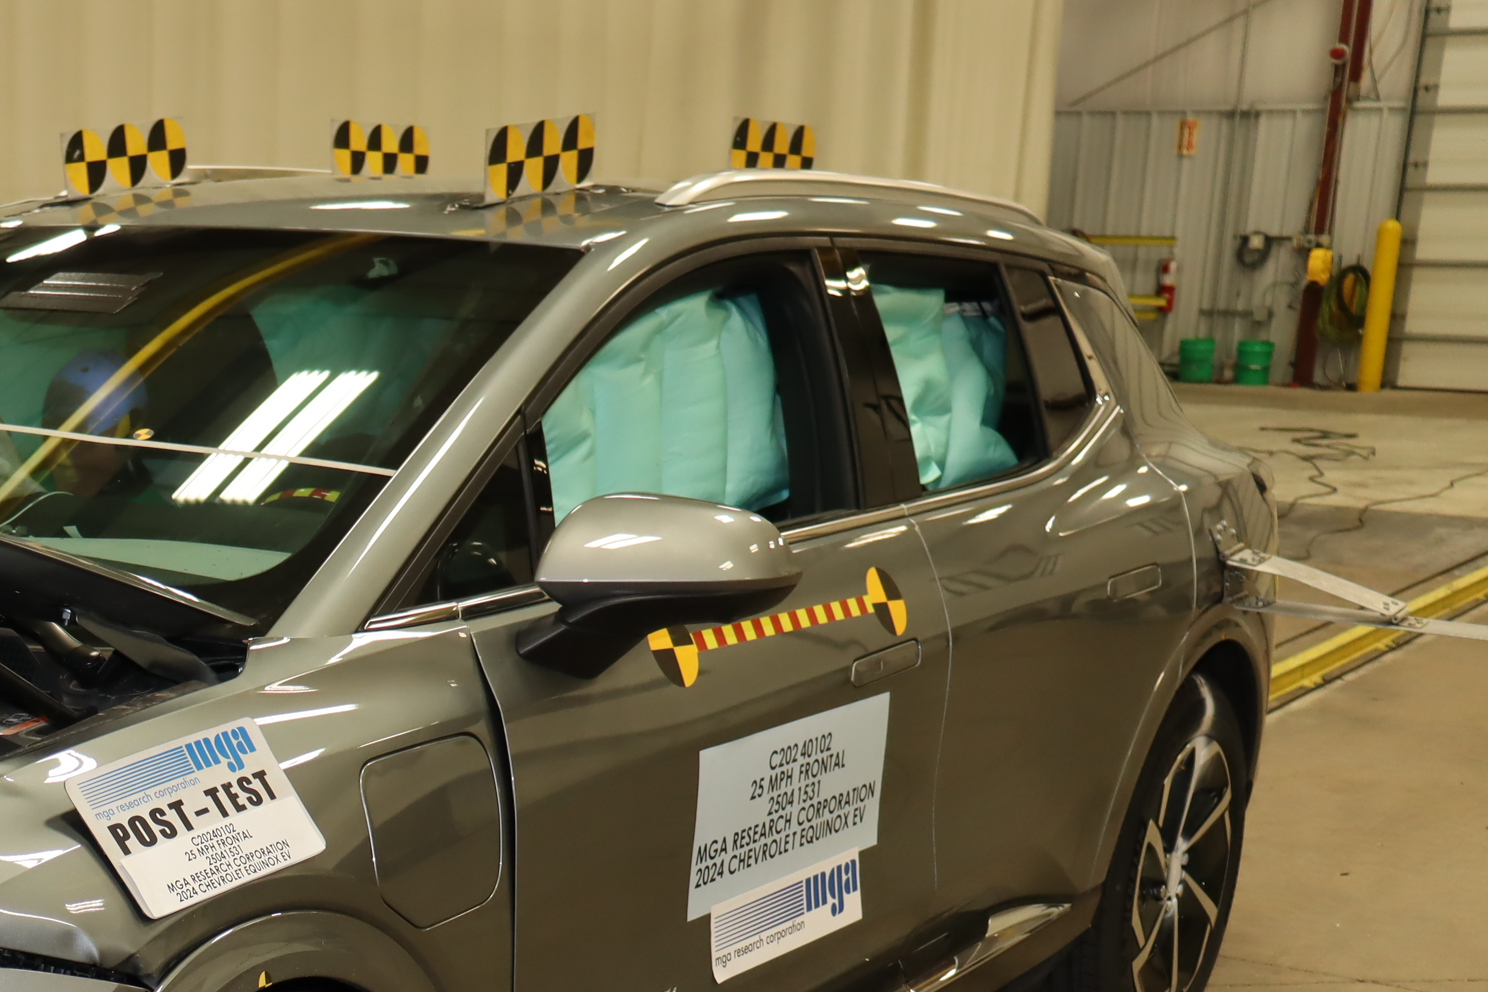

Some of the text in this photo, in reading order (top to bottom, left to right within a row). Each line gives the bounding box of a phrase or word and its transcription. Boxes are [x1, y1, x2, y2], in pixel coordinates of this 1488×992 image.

[185, 726, 257, 773] mga
[94, 775, 201, 821] mga research corporation
[749, 750, 845, 801] 25 MPH FRONTAL
[184, 829, 253, 861] 25 MPH FRONTAL
[191, 823, 237, 846] C20240102
[694, 805, 866, 889] 2024 CHEVROLET EQUINOX EV
[695, 780, 876, 866] MGA RESEARCH CORPORATION
[167, 839, 290, 894] MGA RESEARCH CORPORATION
[176, 850, 292, 902] 2024 CHEVROLET EQUINOX EV
[206, 844, 244, 866] 25041531
[805, 859, 858, 917] mga
[715, 920, 805, 968] mga research corporation
